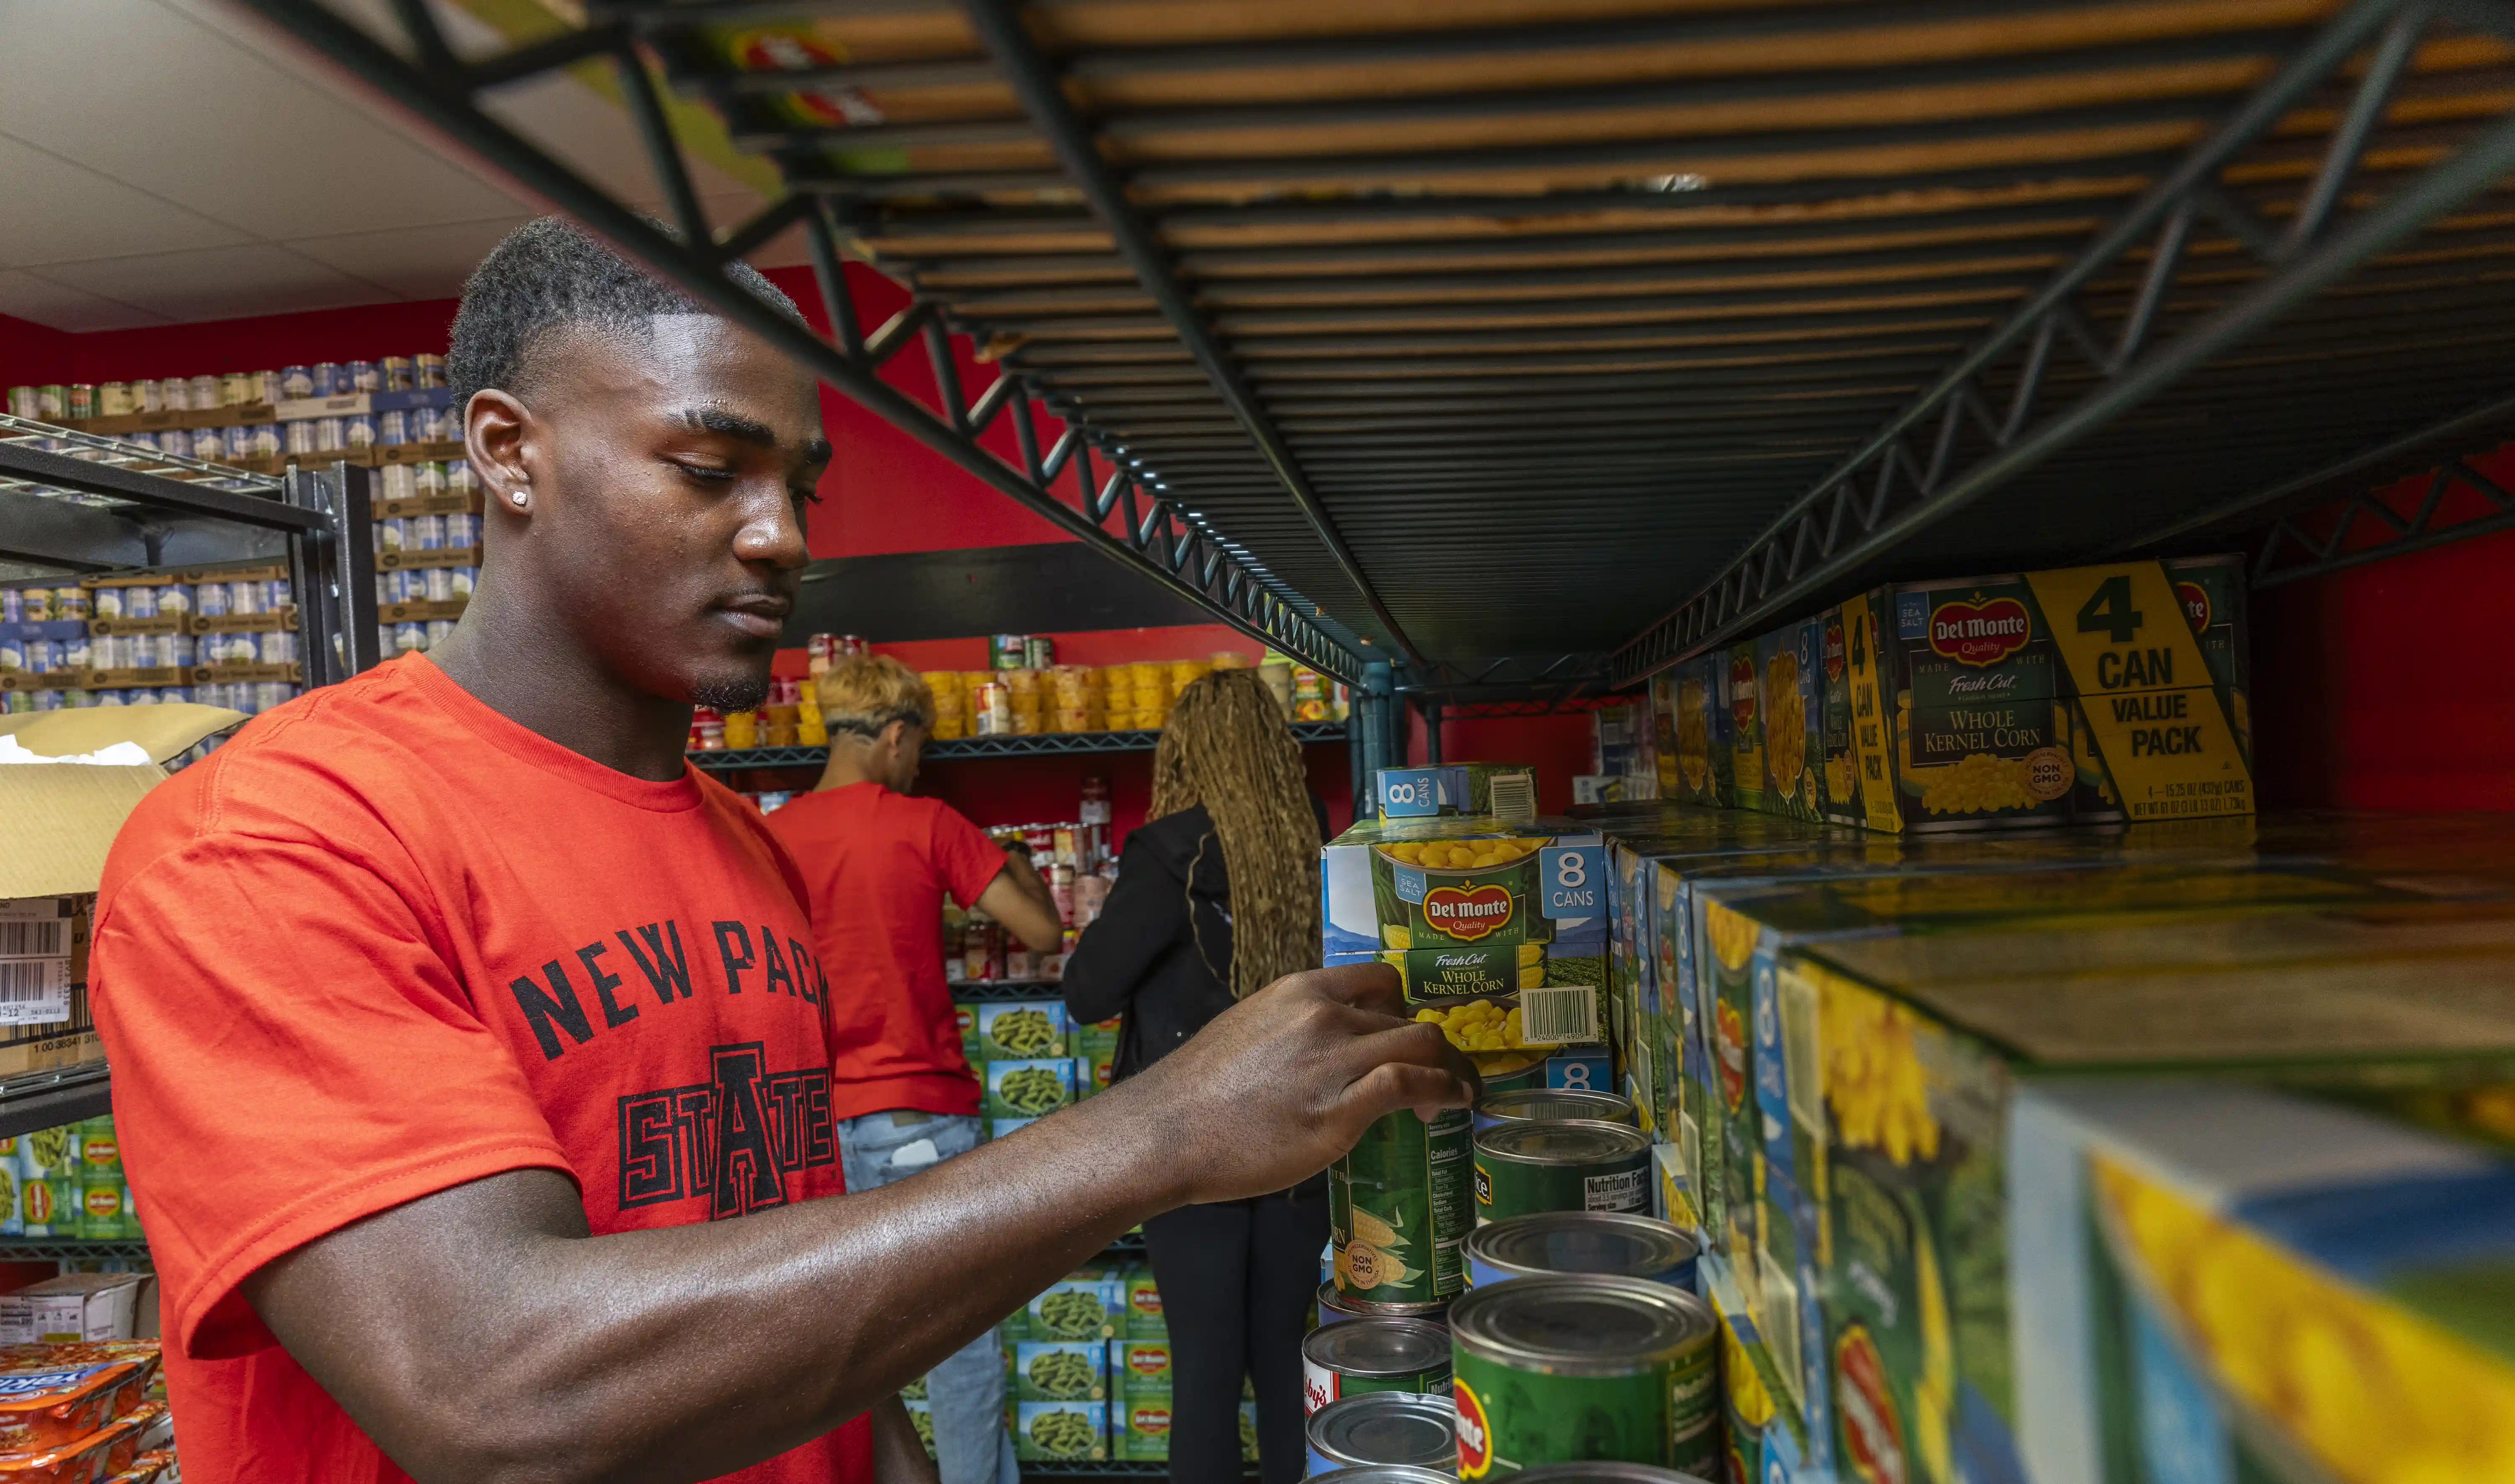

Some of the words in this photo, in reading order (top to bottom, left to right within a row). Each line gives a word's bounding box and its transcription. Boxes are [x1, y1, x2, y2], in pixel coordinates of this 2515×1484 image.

[1903, 609, 1921, 618] SEA
[2077, 575, 2142, 642] 4
[1901, 618, 1924, 627] SALT
[1936, 622, 1964, 640] Del
[1966, 616, 2025, 638] Monte
[1800, 631, 1808, 666] 8
[1852, 615, 1865, 676] 4
[1962, 642, 2000, 655] Quality
[2206, 640, 2225, 649] ITH
[1919, 663, 1950, 674] MADE
[2016, 655, 2045, 666] WITH
[2098, 647, 2172, 689] CAN
[1949, 675, 1987, 694] Fresh
[1987, 674, 2020, 689] Cut
[1856, 682, 1874, 719] CAN
[2111, 694, 2187, 723] VALUE
[1950, 710, 2015, 730] WHOLE
[1860, 724, 1878, 748] VALUE
[1925, 733, 1989, 753] KERNEL
[1994, 728, 2041, 748] CORN
[2131, 726, 2202, 757] PACK
[1866, 754, 1882, 780] PACK
[2033, 764, 2060, 773] NON
[2033, 774, 2061, 783] GMO
[1388, 784, 1415, 804] 8
[1418, 777, 1430, 807] CANS
[2148, 785, 2153, 799] 4
[2187, 782, 2196, 795] OZ
[2224, 780, 2245, 793] CANS
[2134, 802, 2146, 816] NET
[2147, 801, 2158, 815] WT
[2171, 800, 2179, 814] OZ
[1558, 852, 1586, 887] 8
[1400, 885, 1421, 897] SALT
[1401, 879, 1419, 889] SEA
[1430, 901, 1456, 917] Del
[1459, 899, 1507, 917] Monte
[1553, 891, 1594, 907] CANS
[1638, 878, 1643, 920] 8
[1418, 931, 1445, 940] MADE
[1495, 927, 1519, 938] WITH
[1453, 921, 1486, 931] Quality
[1678, 903, 1688, 960] 8
[1435, 954, 1464, 967] Fresh
[1466, 953, 1491, 965] Cut
[1441, 970, 1486, 983] WHOLE
[509, 919, 693, 1061] NEW
[1423, 981, 1470, 995] KERNEL
[1471, 978, 1504, 993] CORN
[1758, 968, 1775, 1047] 8
[34, 1045, 39, 1054] 1
[42, 1042, 54, 1052] 00
[1563, 1063, 1591, 1090] 8
[617, 1041, 836, 1222] STATE
[1430, 1147, 1458, 1160] Calories
[1331, 1169, 1345, 1181] ITH
[1432, 1190, 1454, 1199] Cholesterol
[1587, 1176, 1630, 1194] Nutrition
[1350, 1243, 1378, 1262] PRESERVATIVES
[1352, 1254, 1372, 1265] NON
[1352, 1264, 1373, 1274] GMO
[1304, 1374, 1327, 1409] bby's
